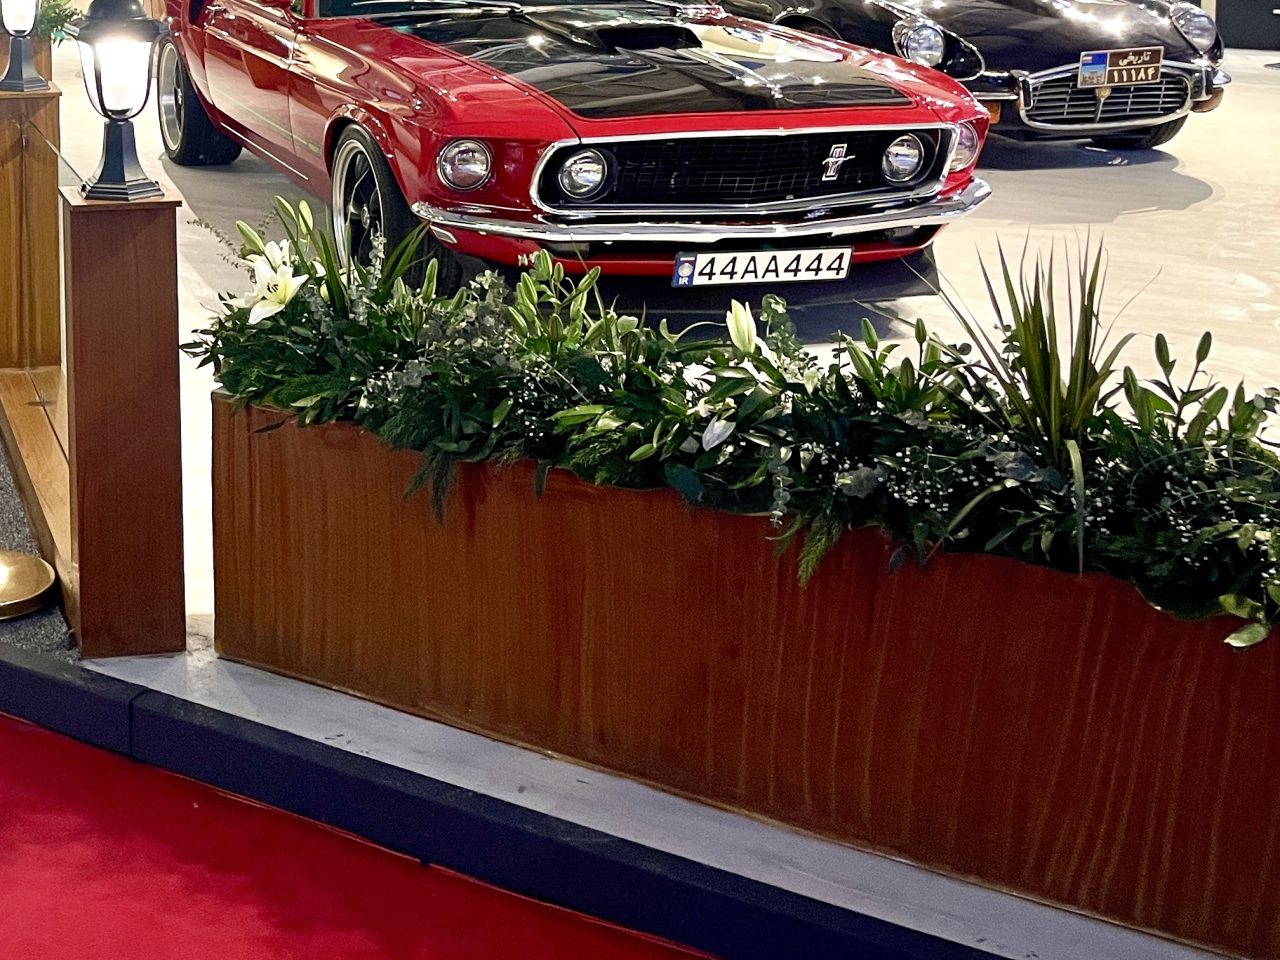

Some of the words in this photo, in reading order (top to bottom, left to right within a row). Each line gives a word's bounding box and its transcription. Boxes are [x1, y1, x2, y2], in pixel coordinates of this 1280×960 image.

[1118, 51, 1152, 66] تاریخی
[1113, 67, 1156, 83] ۱۱۱۸۴
[697, 252, 845, 281] 44AA444
